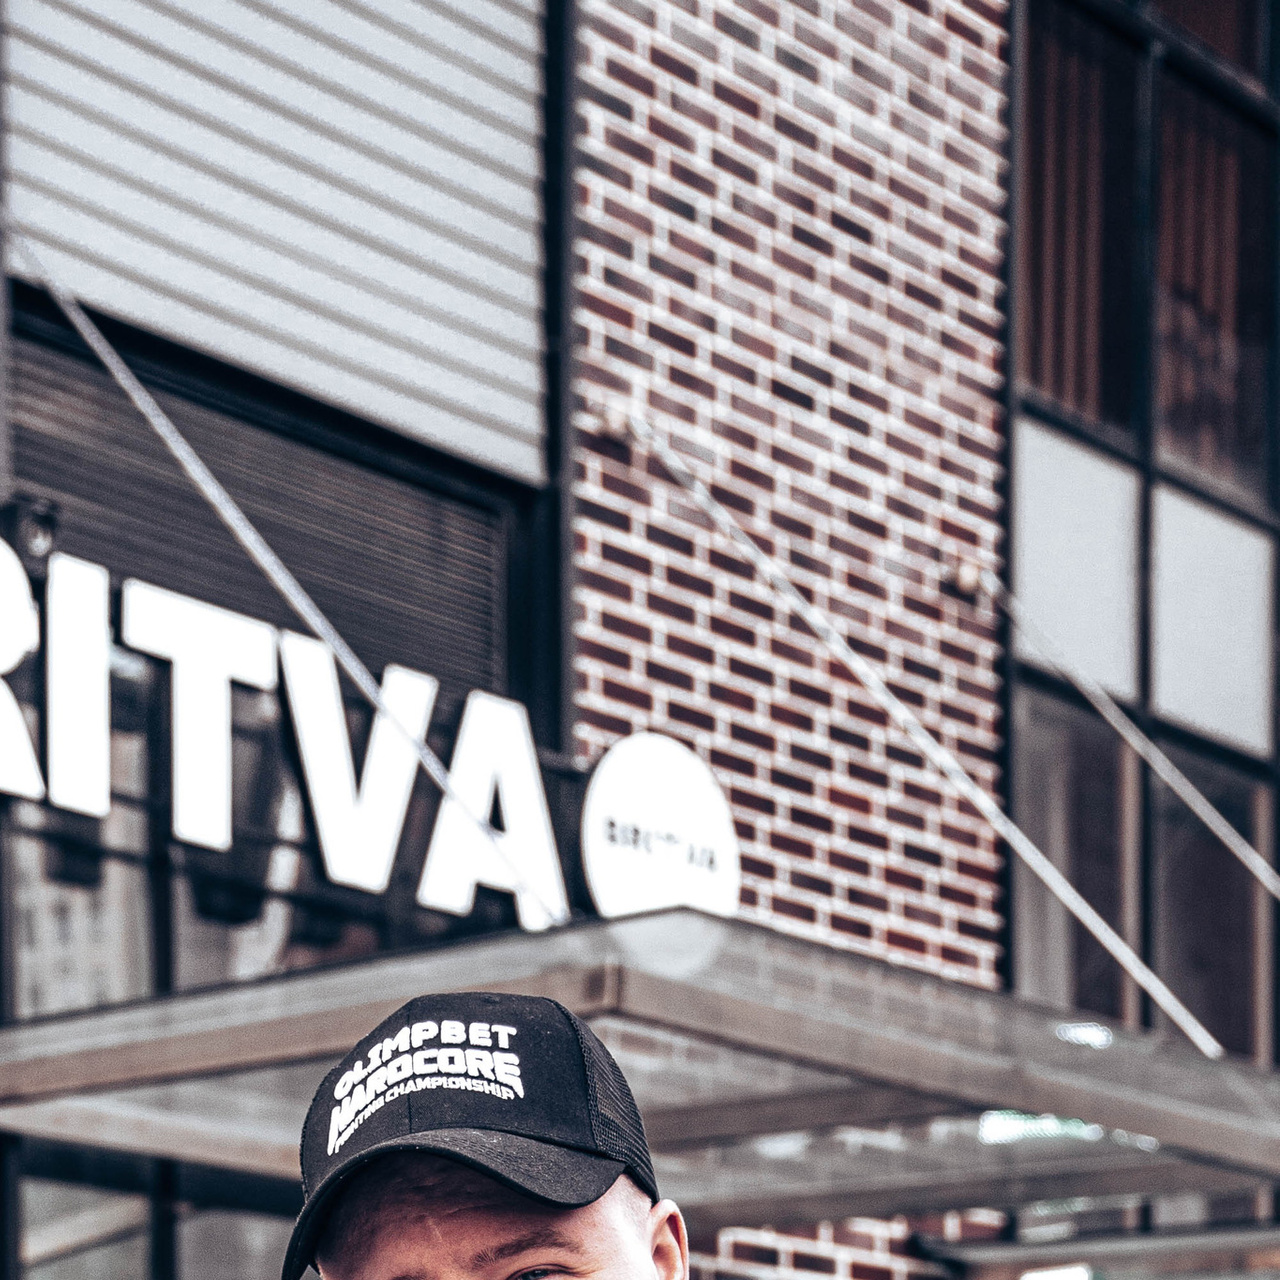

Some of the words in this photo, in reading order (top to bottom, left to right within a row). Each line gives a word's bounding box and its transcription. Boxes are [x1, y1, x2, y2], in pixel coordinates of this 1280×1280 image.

[333, 1020, 517, 1100] OLIMPBET
[384, 1076, 515, 1100] CHAMPIONSHIP
[326, 1048, 525, 1157] HARDCORE
